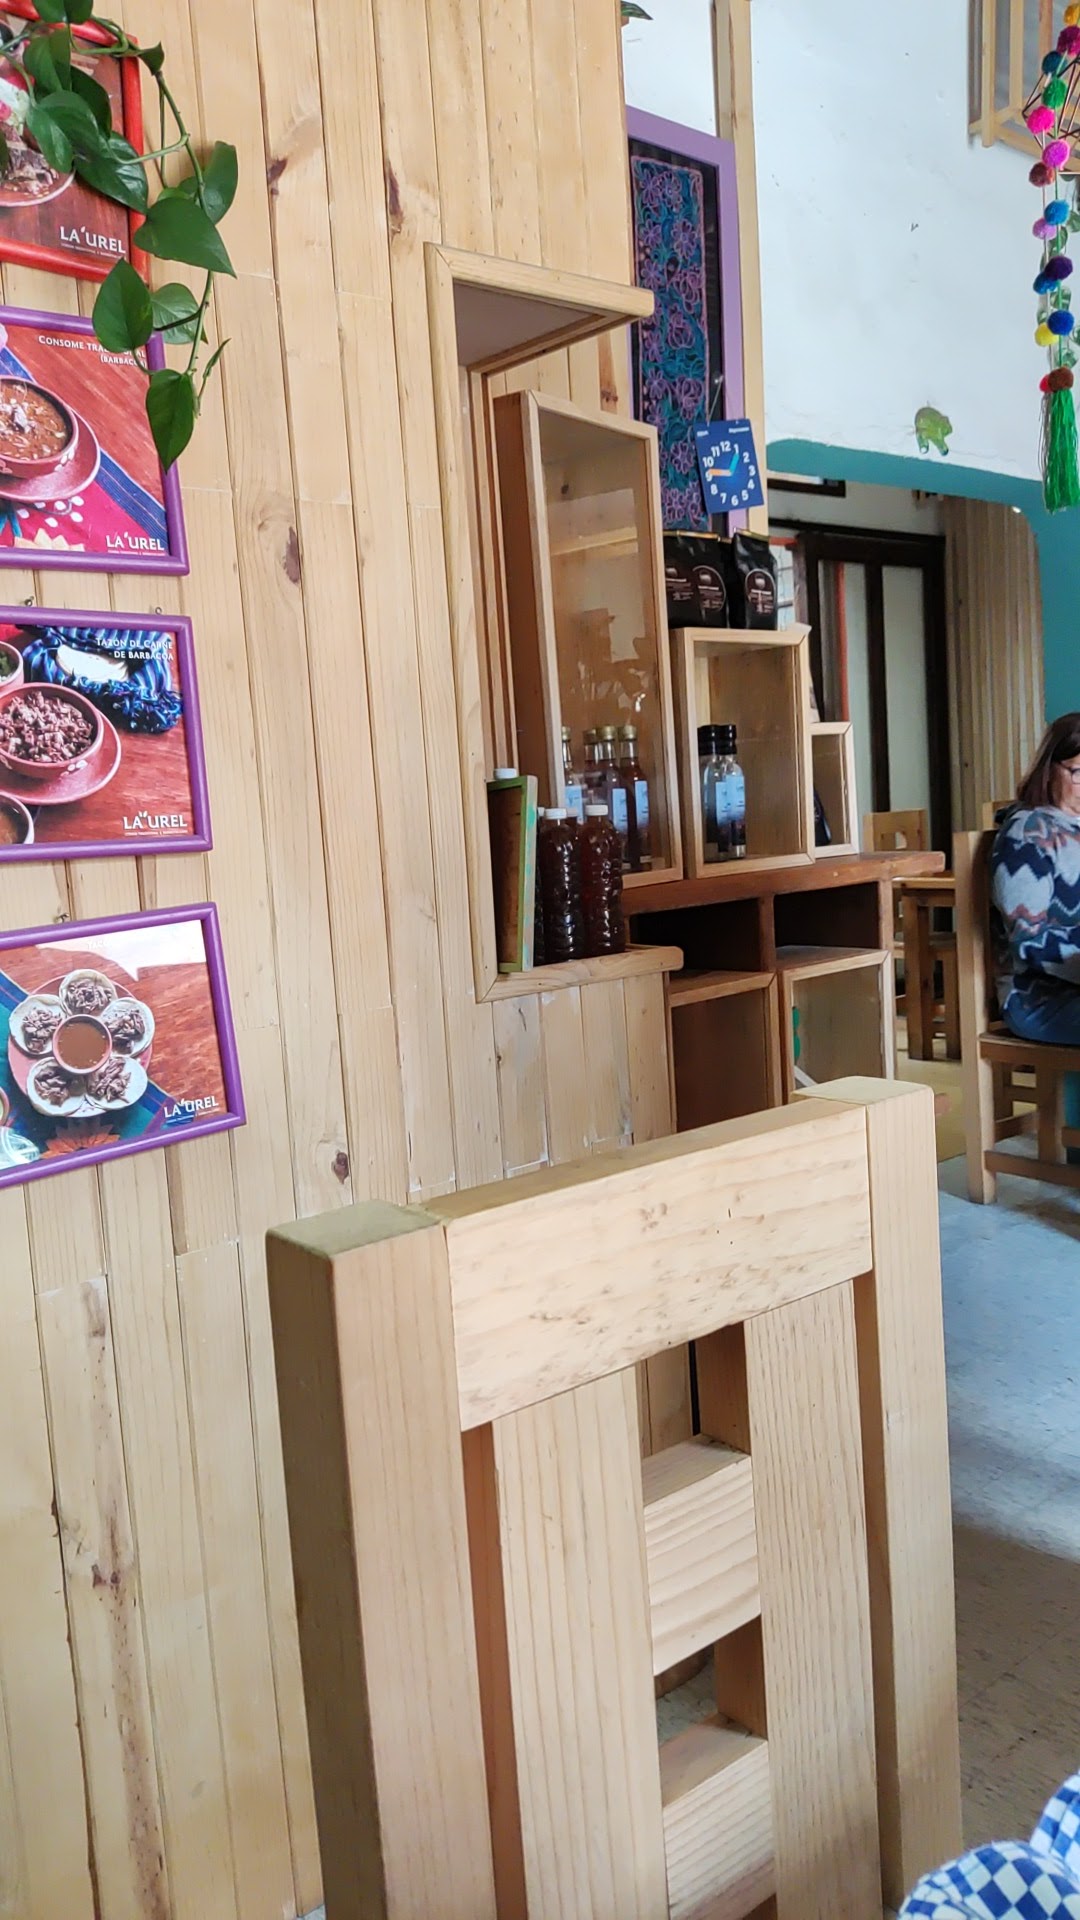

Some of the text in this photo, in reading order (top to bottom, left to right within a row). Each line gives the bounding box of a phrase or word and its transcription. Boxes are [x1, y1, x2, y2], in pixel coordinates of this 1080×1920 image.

[38, 335, 84, 349] CONSOME
[711, 446, 720, 457] 11
[720, 440, 732, 452] 12
[734, 443, 740, 454] 1
[702, 456, 714, 468] 10
[743, 452, 750, 463] 2
[748, 465, 756, 476] 3
[711, 484, 718, 495] 8
[748, 478, 755, 490] 4
[720, 492, 727, 504] 7
[731, 495, 739, 506] 6
[741, 489, 749, 501] 5
[113, 650, 174, 661] DE BARBACOA
